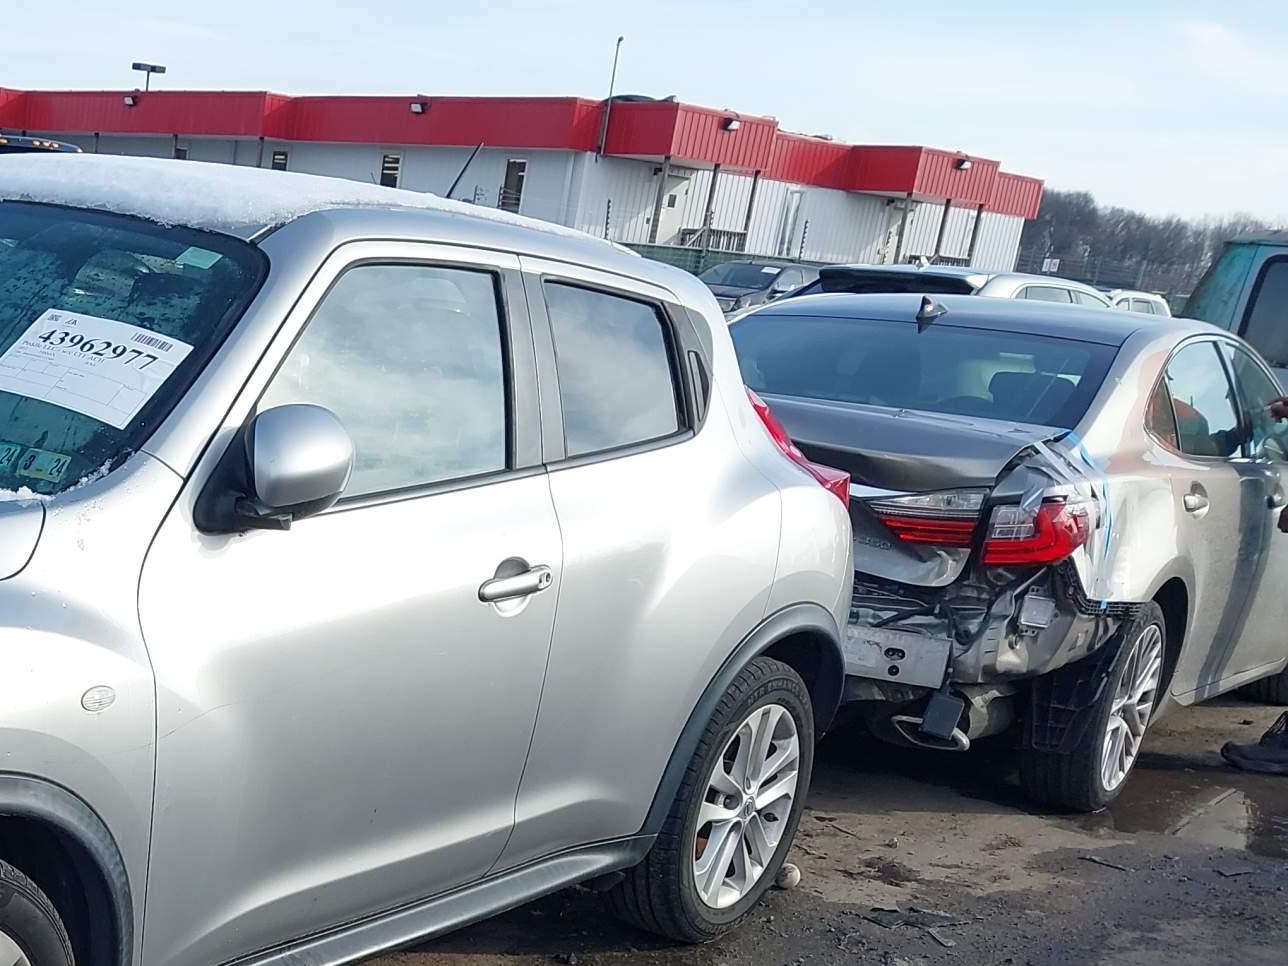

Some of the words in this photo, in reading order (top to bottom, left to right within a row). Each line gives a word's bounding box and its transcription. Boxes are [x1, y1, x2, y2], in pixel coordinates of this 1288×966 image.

[38, 329, 159, 370] 43962977
[0, 447, 17, 465] 24
[49, 458, 67, 477] 24
